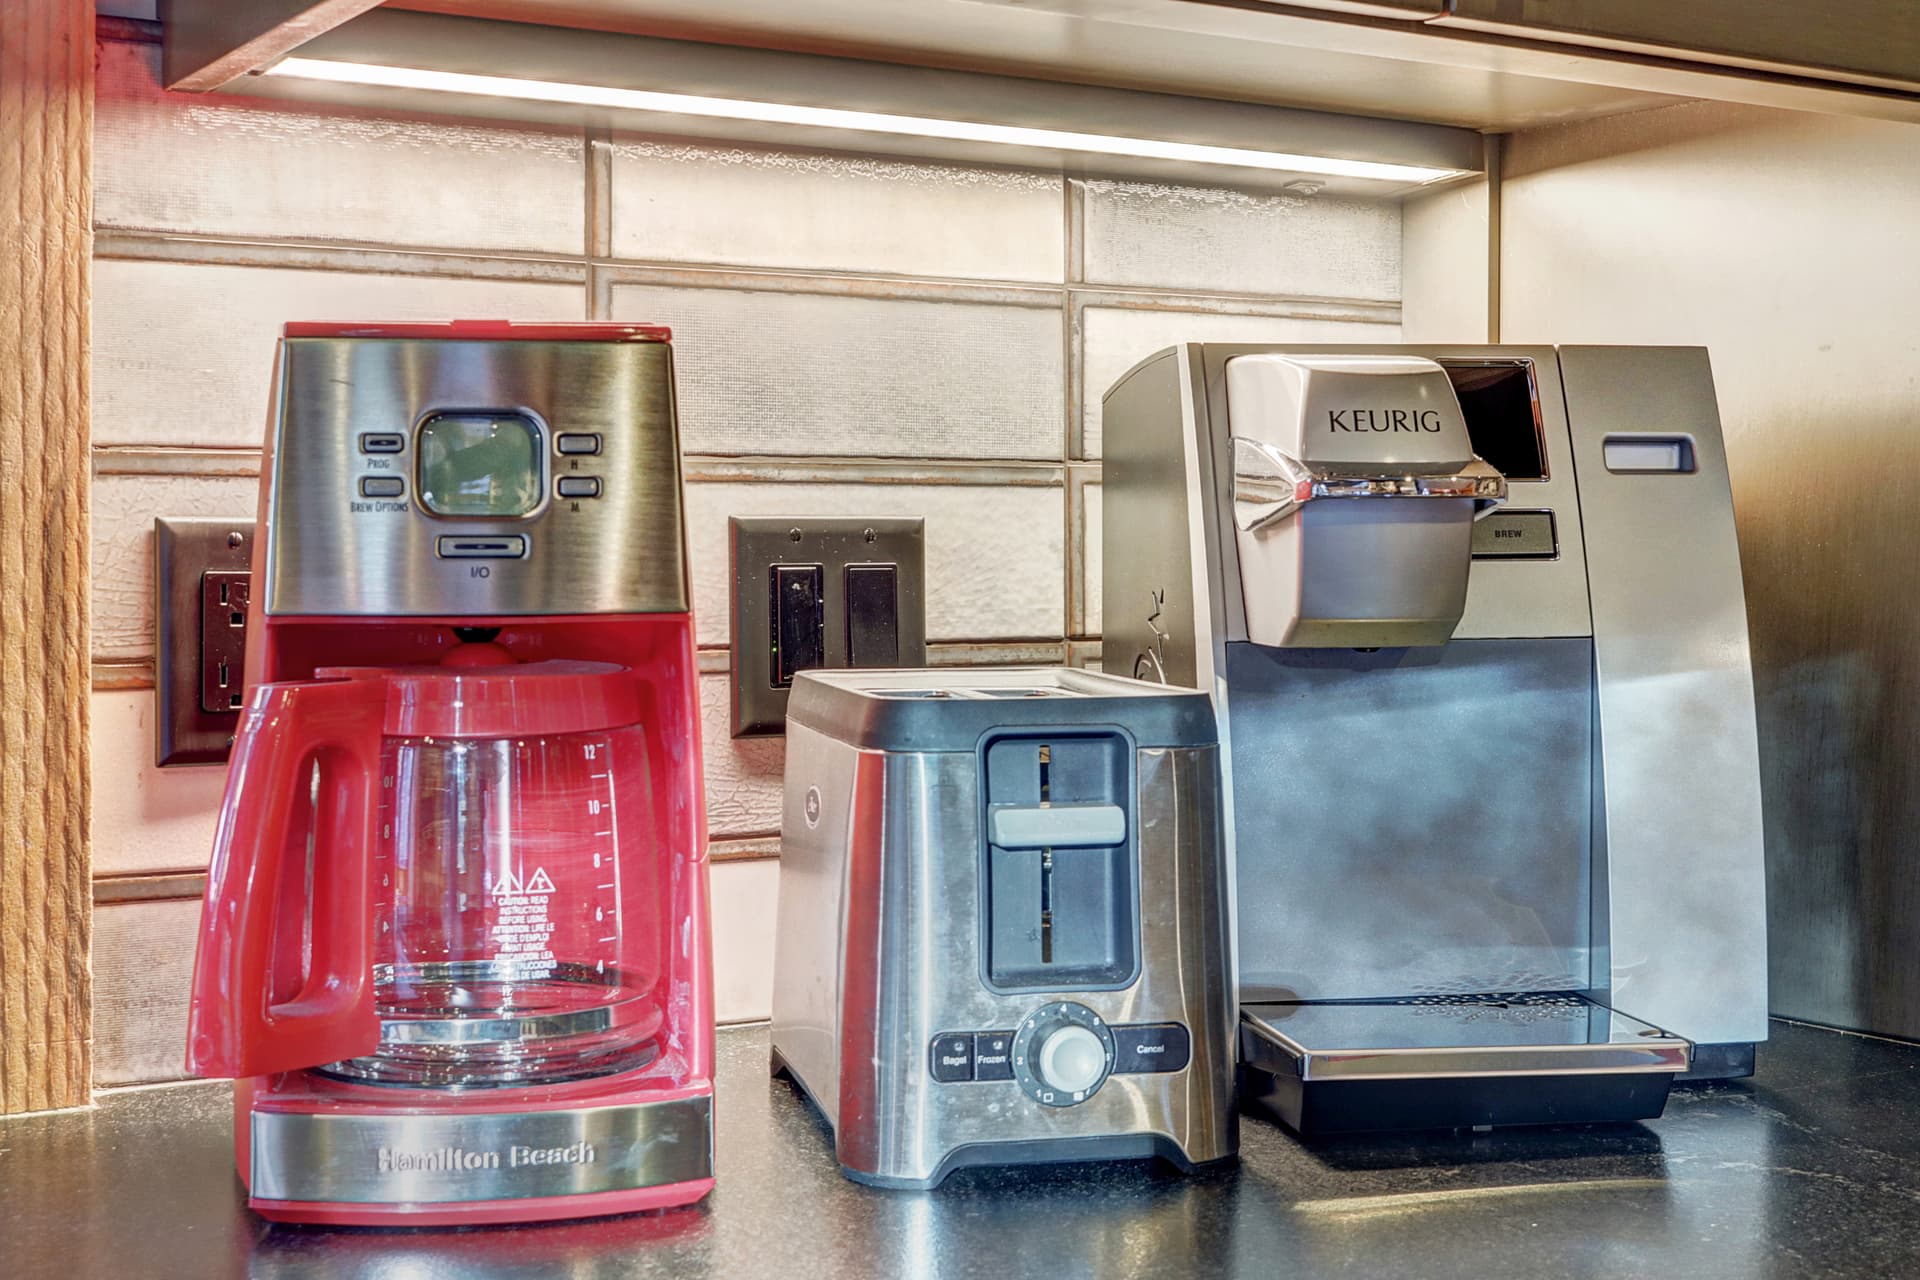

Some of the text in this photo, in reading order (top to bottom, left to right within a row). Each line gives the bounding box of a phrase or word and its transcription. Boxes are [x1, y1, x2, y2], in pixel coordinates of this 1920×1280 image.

[1328, 409, 1441, 433] KEURIG
[367, 458, 390, 469] PROG
[571, 459, 578, 470] H
[350, 501, 409, 512] BREW OPTIONS
[571, 502, 580, 512] M
[1494, 529, 1522, 538] BREW
[470, 566, 490, 578] I/O
[583, 745, 596, 760] 12
[588, 799, 600, 815] 10
[593, 853, 600, 868] 8
[595, 906, 603, 922] 6
[596, 960, 604, 974] 4
[1136, 1044, 1165, 1054] Cancel
[943, 1055, 968, 1066] Bagel
[977, 1055, 1006, 1065] Frozen
[1016, 1056, 1024, 1065] 2
[378, 1140, 595, 1173] Hamilton Beach
